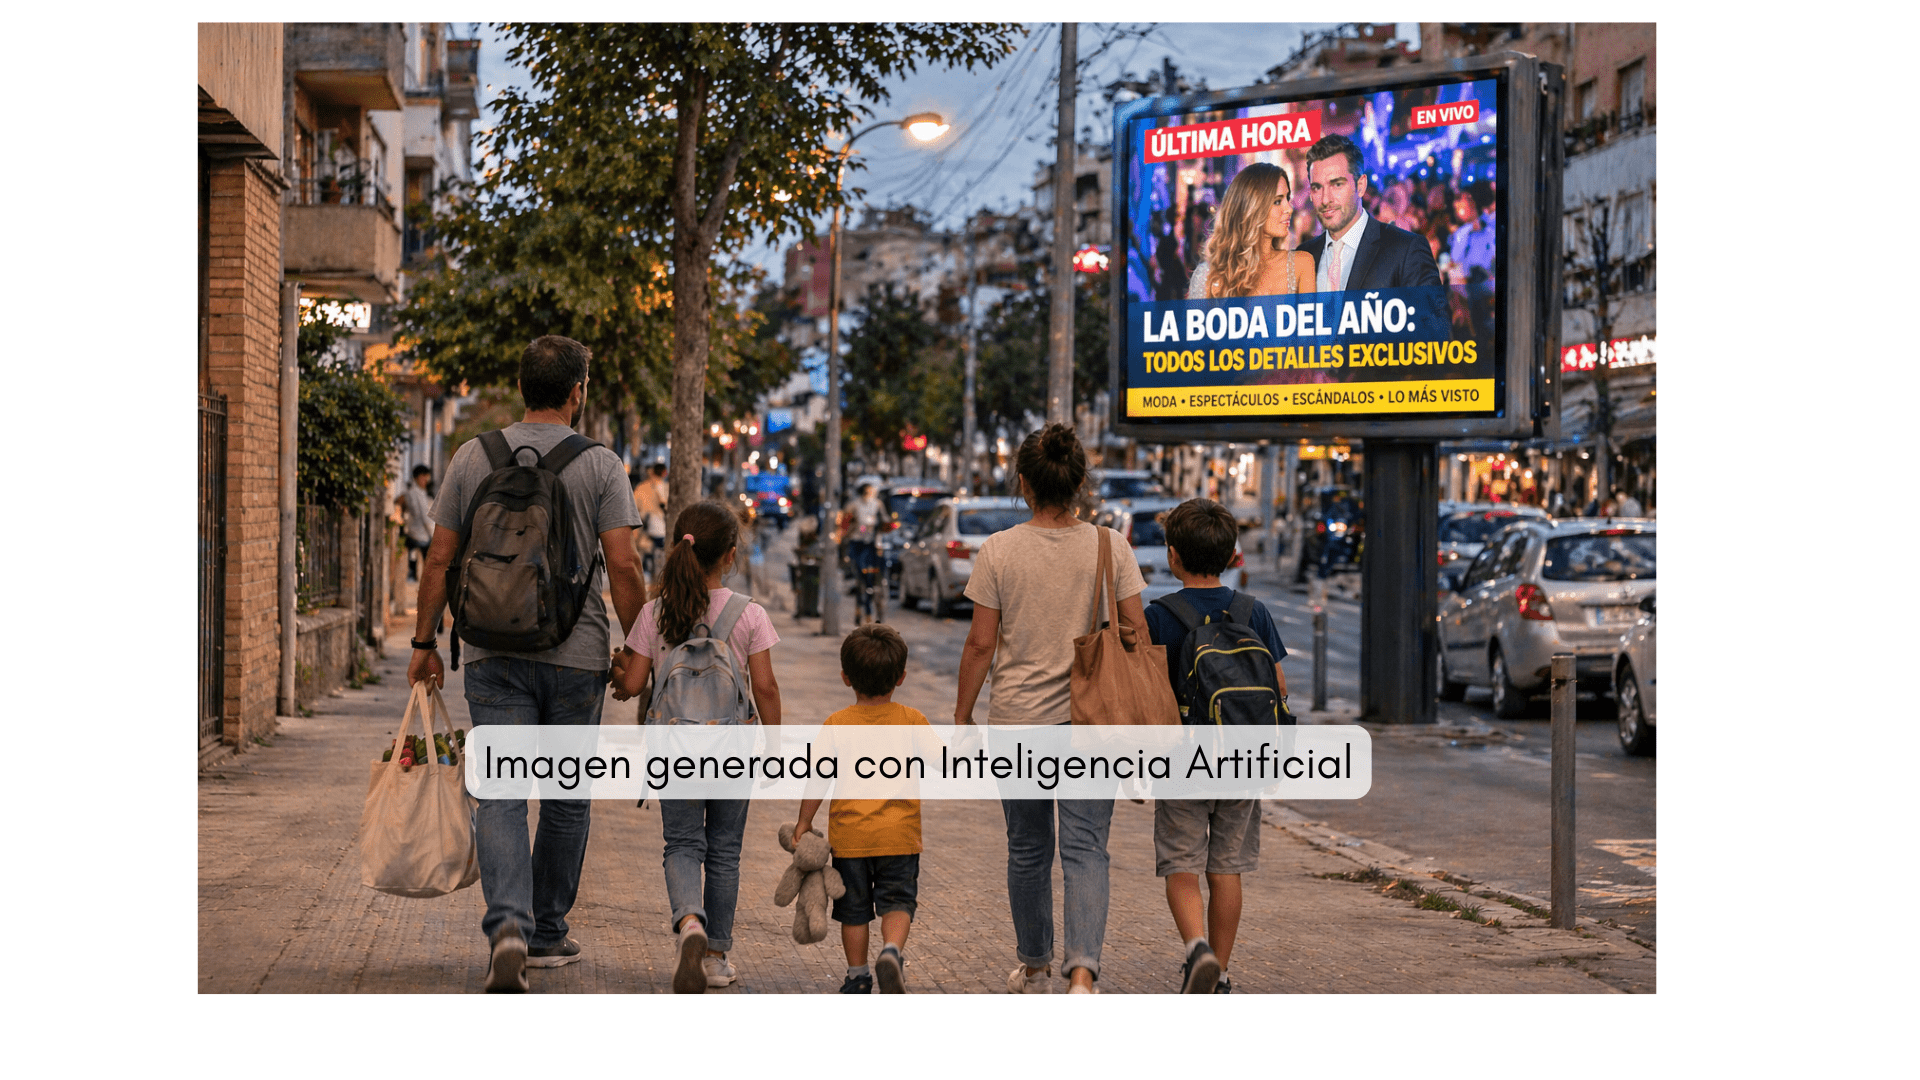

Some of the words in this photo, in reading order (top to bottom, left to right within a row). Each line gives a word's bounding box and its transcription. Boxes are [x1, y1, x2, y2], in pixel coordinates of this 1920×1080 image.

[1417, 110, 1436, 125] EN
[1439, 105, 1475, 123] VIVO
[1152, 127, 1235, 158] ÚLTIMA
[1241, 117, 1311, 149] HORA
[1143, 310, 1181, 342] LA
[1186, 305, 1269, 341] BODA
[1277, 302, 1332, 337] DEL
[1338, 291, 1415, 335] AÑO:
[1143, 350, 1205, 373] TODOS
[1209, 349, 1244, 370] LOS
[1250, 345, 1343, 370] DETALLES
[1349, 340, 1477, 367] EXCLUSIVOS
[1143, 395, 1177, 408] MODA
[1190, 389, 1279, 407] ESPECTÁCULOS
[1292, 387, 1375, 406] ESCÁNDALOS
[1388, 390, 1405, 403] LO
[1408, 384, 1438, 403] MÁS
[1441, 387, 1480, 402] VISTO
